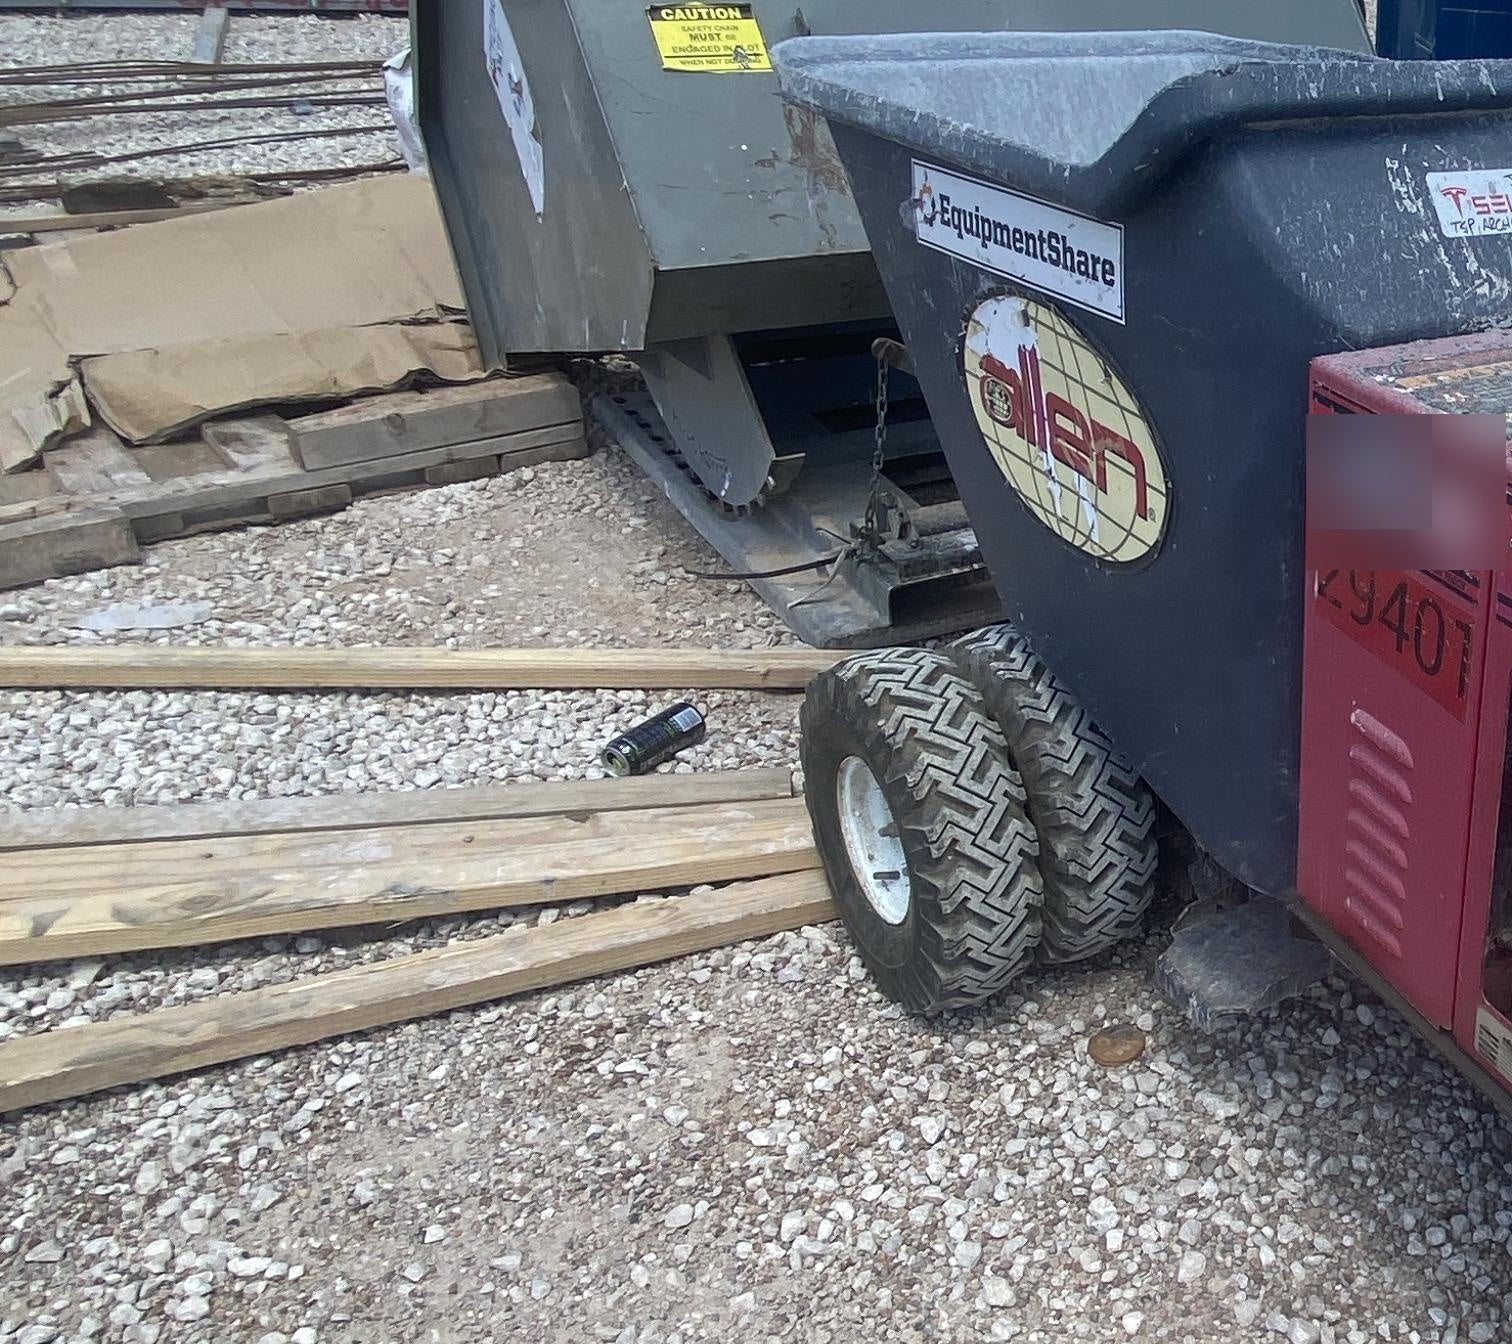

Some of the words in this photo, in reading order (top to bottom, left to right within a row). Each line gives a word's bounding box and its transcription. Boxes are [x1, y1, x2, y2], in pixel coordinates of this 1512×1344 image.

[660, 7, 742, 21] CAUTION
[689, 33, 722, 42] MUST
[938, 192, 1116, 288] EquipmentShare
[979, 340, 1148, 522] allen
